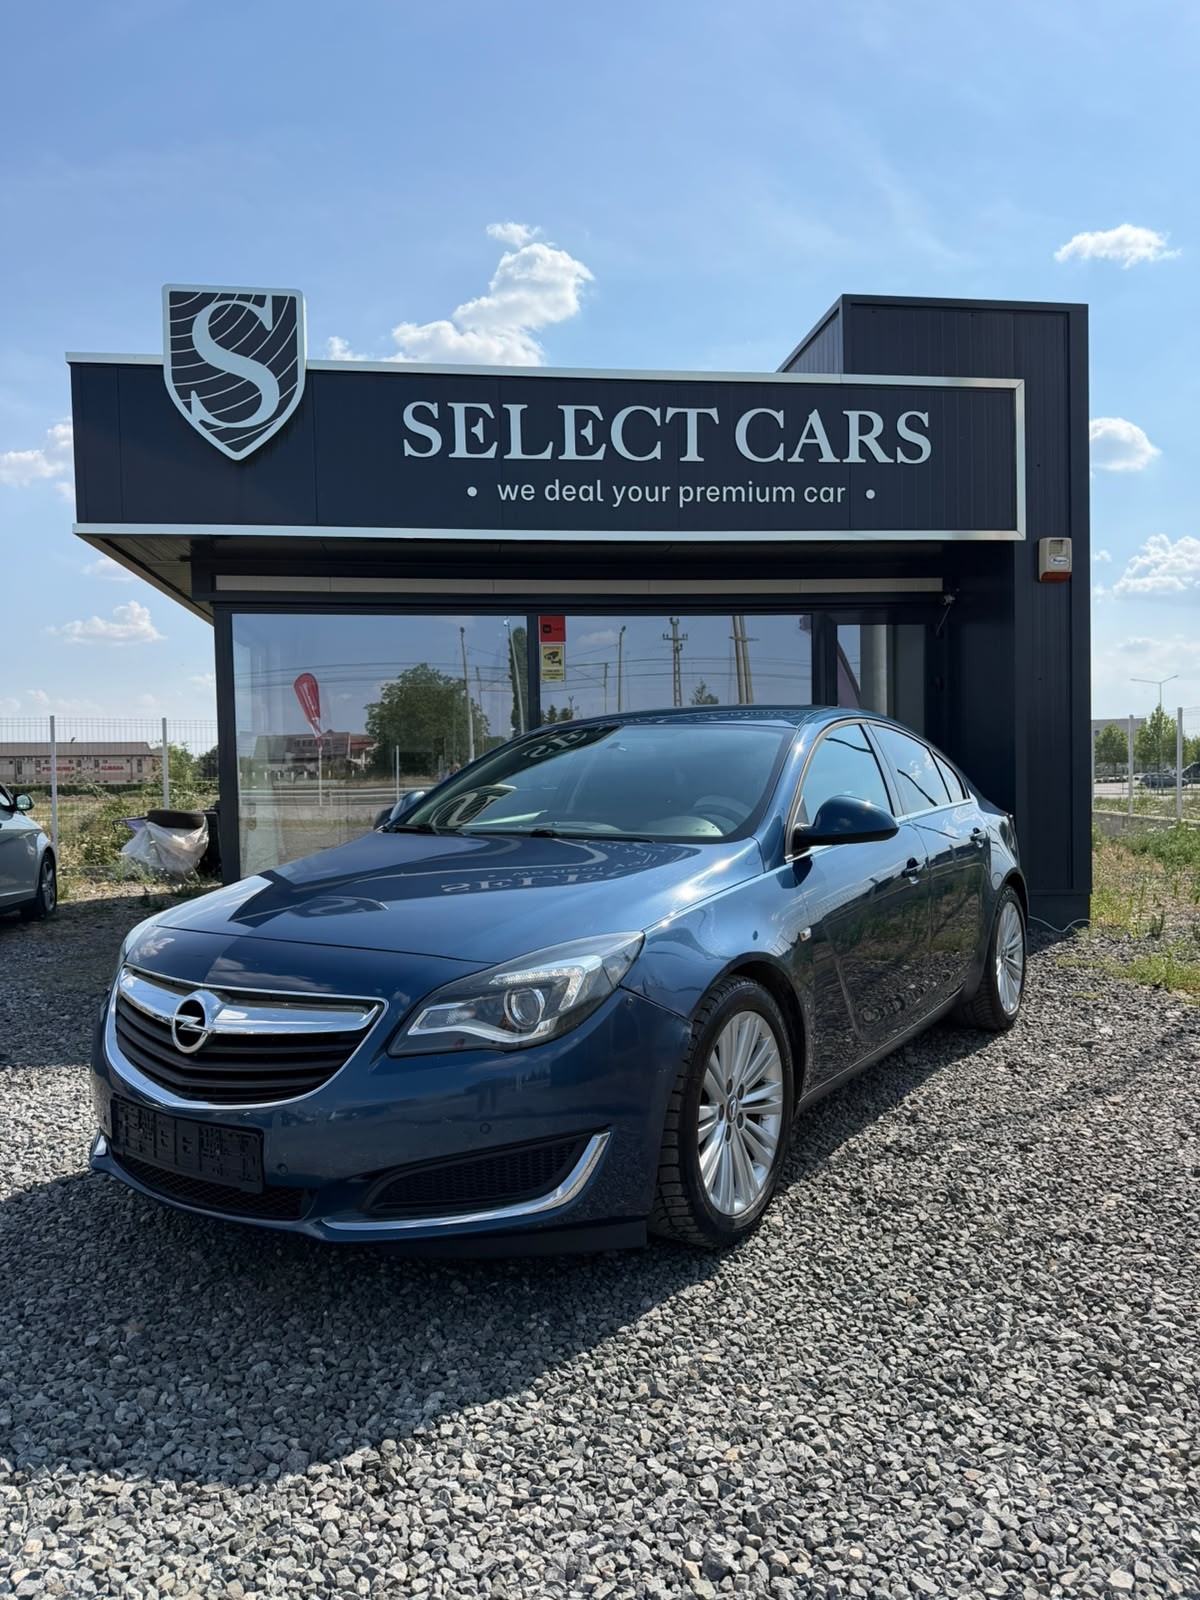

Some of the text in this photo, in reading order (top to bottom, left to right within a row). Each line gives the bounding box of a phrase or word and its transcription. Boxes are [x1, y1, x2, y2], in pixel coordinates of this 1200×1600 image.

[191, 295, 280, 428] S
[402, 401, 932, 464] SELECT CARS
[497, 478, 846, 508] we deal your premium car
